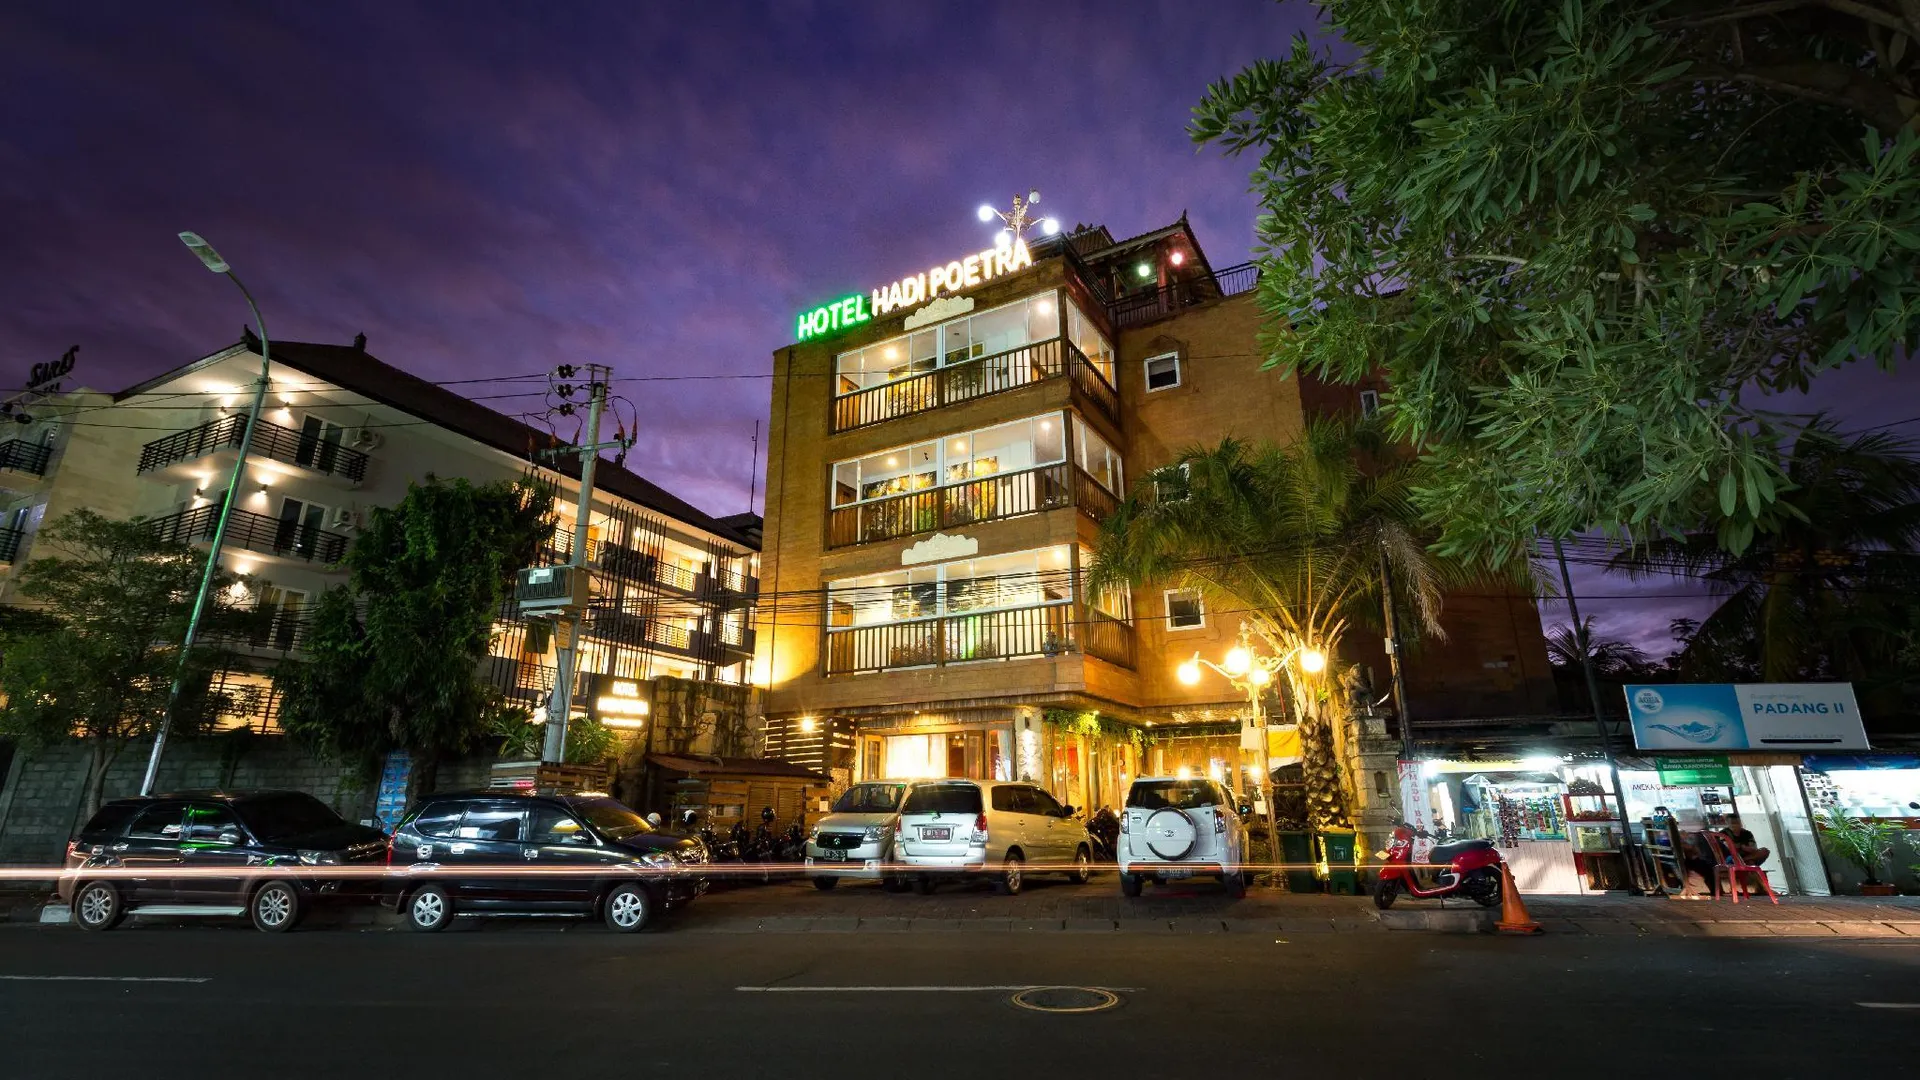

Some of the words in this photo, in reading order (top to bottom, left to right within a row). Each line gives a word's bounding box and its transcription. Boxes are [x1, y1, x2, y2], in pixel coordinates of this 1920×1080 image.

[798, 294, 869, 340] HOTEL
[871, 272, 925, 317] HADI
[930, 238, 1032, 297] POETRA
[1753, 702, 1829, 714] PADANG
[1833, 702, 1845, 714] II
